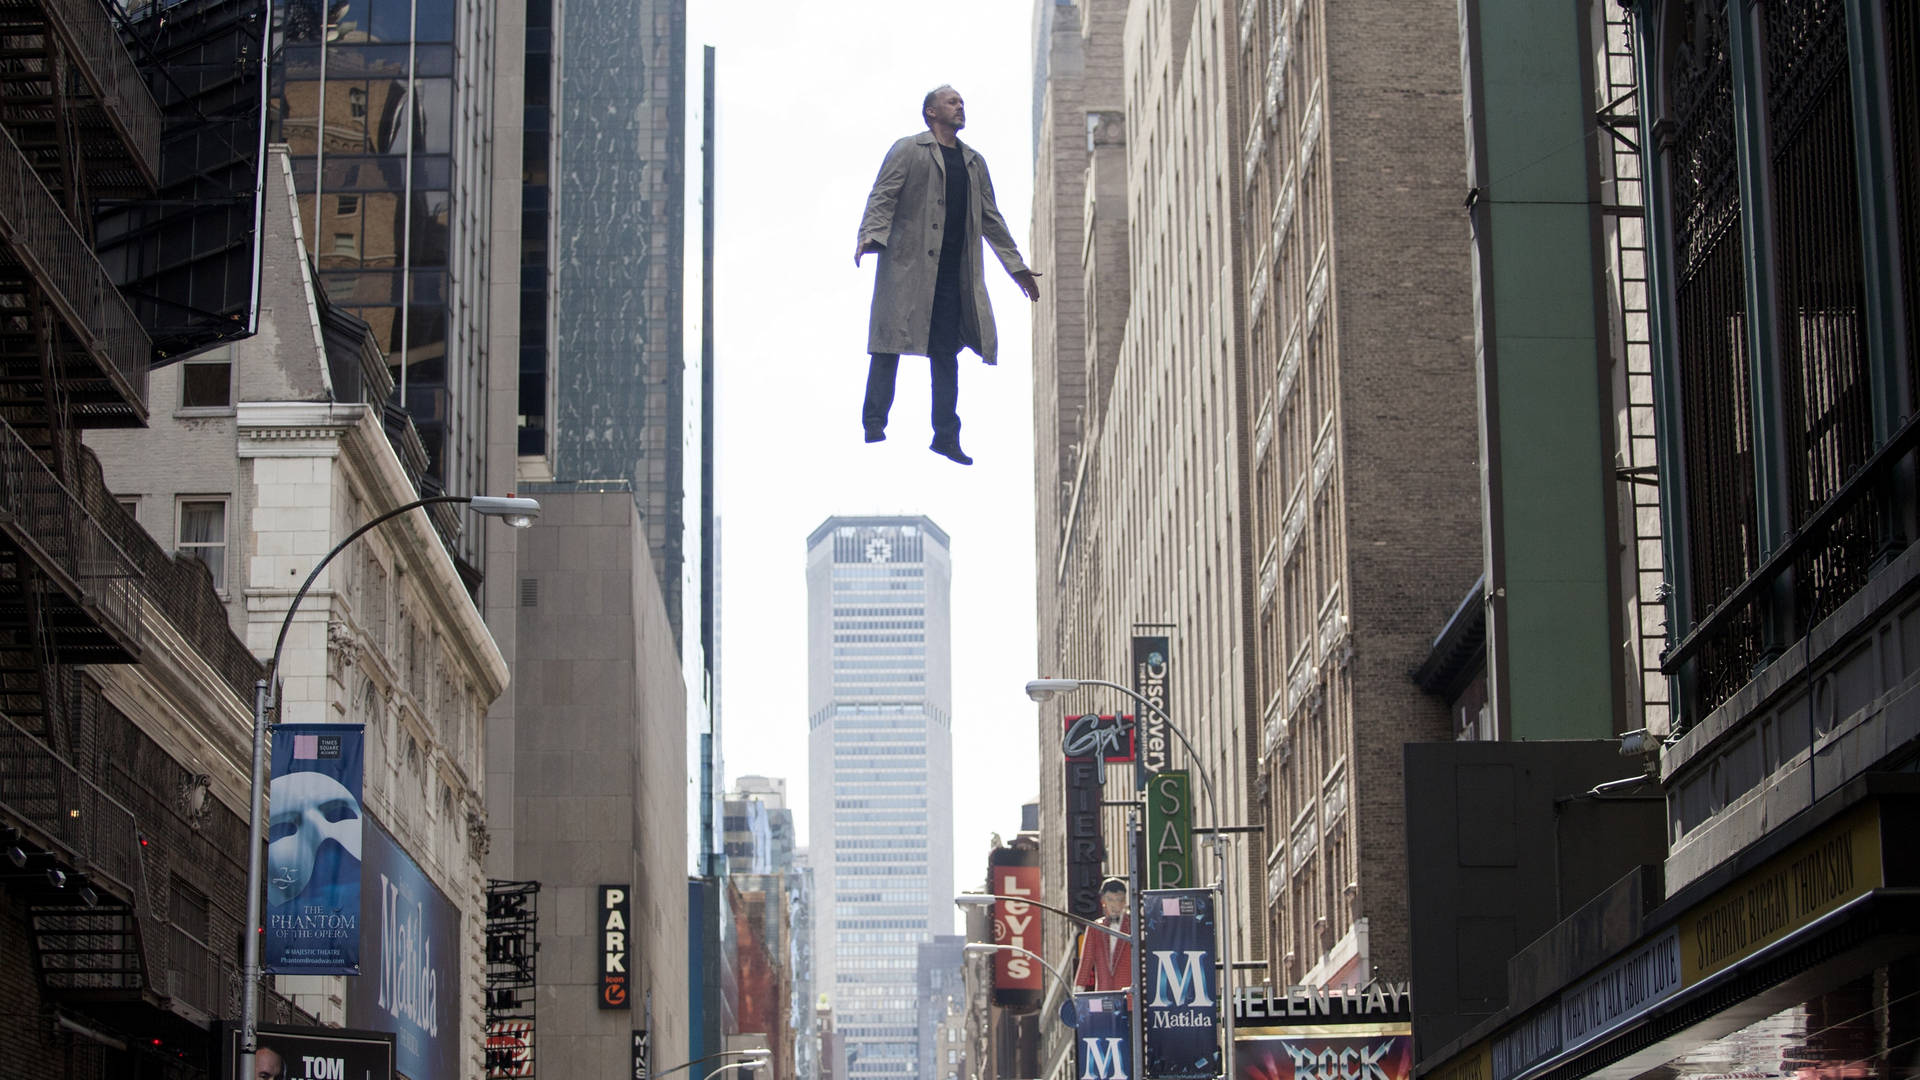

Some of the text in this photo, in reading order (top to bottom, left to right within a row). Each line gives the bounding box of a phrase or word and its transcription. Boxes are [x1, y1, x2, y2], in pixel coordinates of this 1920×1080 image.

[1145, 655, 1167, 773] Discovery
[303, 905, 324, 914] THE
[1696, 828, 1855, 970] STARRING RIGGAN THOMSON
[271, 914, 355, 929] PHANTOM
[275, 929, 349, 938] OF THE OPERA
[605, 889, 626, 973] PARK
[378, 873, 438, 1038] Matilda
[1149, 951, 1214, 1007] M
[1600, 967, 1623, 1022] TALK
[1623, 950, 1651, 1012] ABOUT
[1652, 935, 1677, 994] LOVE
[1153, 1009, 1213, 1029] Matilda
[302, 1055, 345, 1080] TOM
[1080, 1037, 1129, 1080] M
[1281, 1036, 1397, 1080] ROCK
